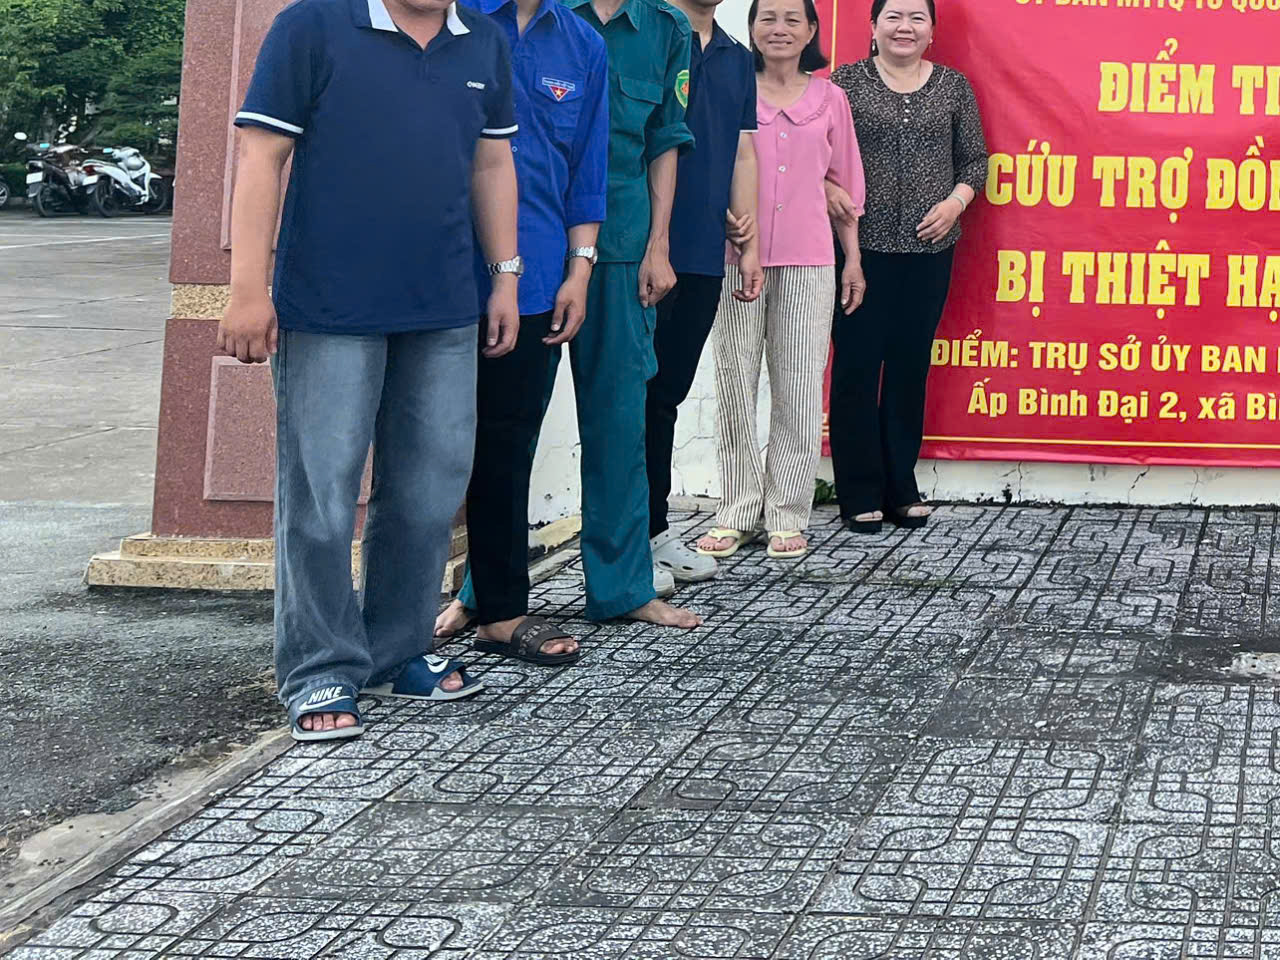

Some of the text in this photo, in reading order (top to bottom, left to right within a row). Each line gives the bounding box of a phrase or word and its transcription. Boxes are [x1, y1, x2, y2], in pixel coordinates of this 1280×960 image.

[1097, 37, 1216, 115] ĐIỂM
[985, 139, 1078, 207] CỨU
[1092, 146, 1194, 224] TRỢ
[995, 250, 1046, 318] BỊ
[1062, 239, 1210, 320] THIỆT
[930, 329, 1019, 368] ĐIỂM:
[1028, 341, 1088, 376] TRỤ
[1098, 334, 1142, 371] SỞ
[1151, 335, 1191, 372] ỦY
[1201, 345, 1267, 373] BAN
[967, 377, 1008, 418] Ấp
[1018, 388, 1088, 417] Bình
[1097, 390, 1149, 424] Đại
[1159, 391, 1187, 422] 2,
[1197, 392, 1236, 420] xã
[308, 685, 343, 704] NIKE
